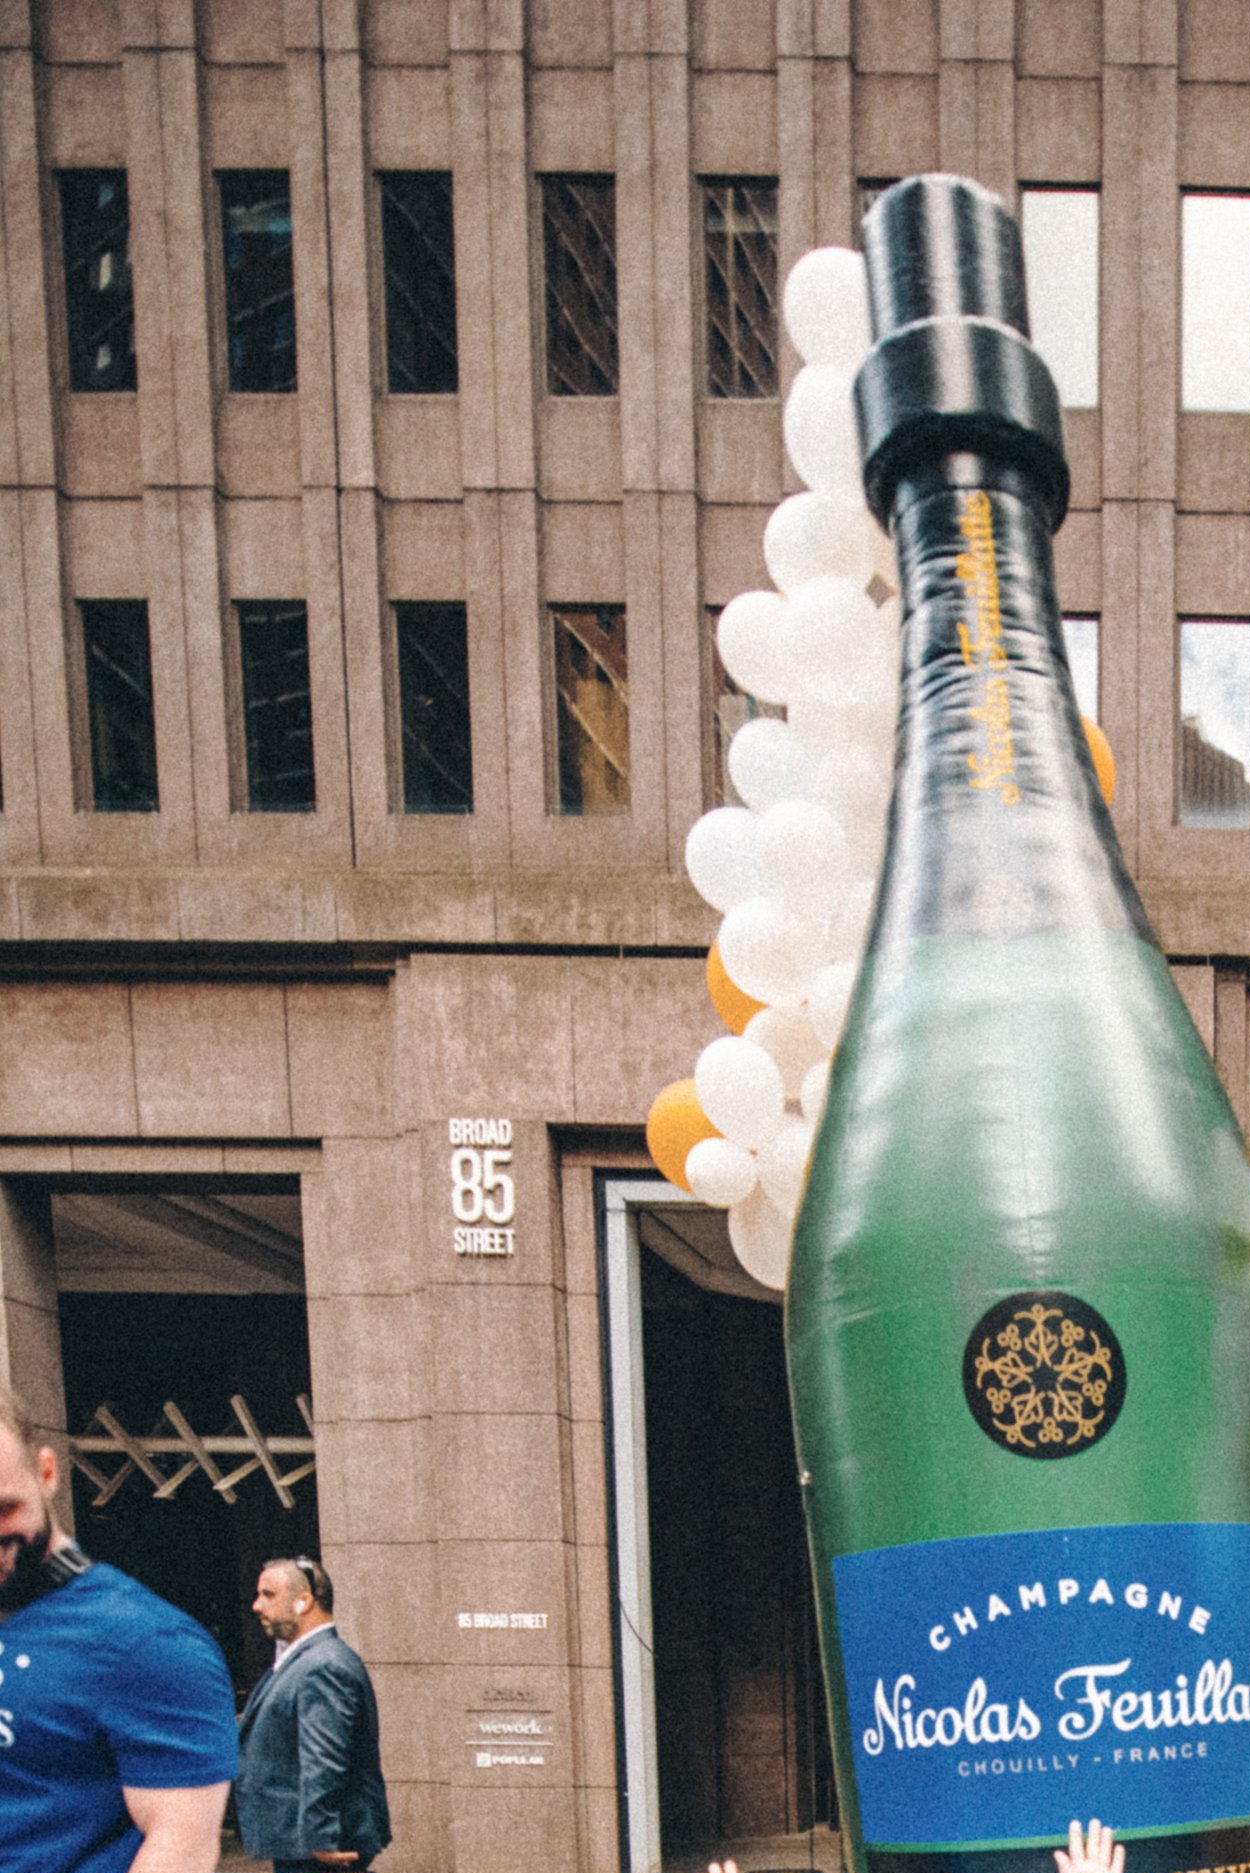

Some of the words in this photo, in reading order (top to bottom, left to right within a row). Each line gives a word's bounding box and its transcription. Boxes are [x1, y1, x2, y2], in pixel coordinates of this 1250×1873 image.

[449, 1117, 512, 1146] BROAD
[451, 1147, 516, 1224] 85
[453, 1226, 516, 1256] STREET
[457, 1612, 472, 1629] 85
[473, 1612, 509, 1629] BROAD
[509, 1612, 549, 1630] STREET
[929, 1578, 1212, 1651] CHAMPAGNE
[479, 1719, 542, 1735] wework
[863, 1674, 1042, 1756] Nicolas
[957, 1754, 1080, 1777] CHOUILLY
[1113, 1741, 1209, 1765] FRANCE
